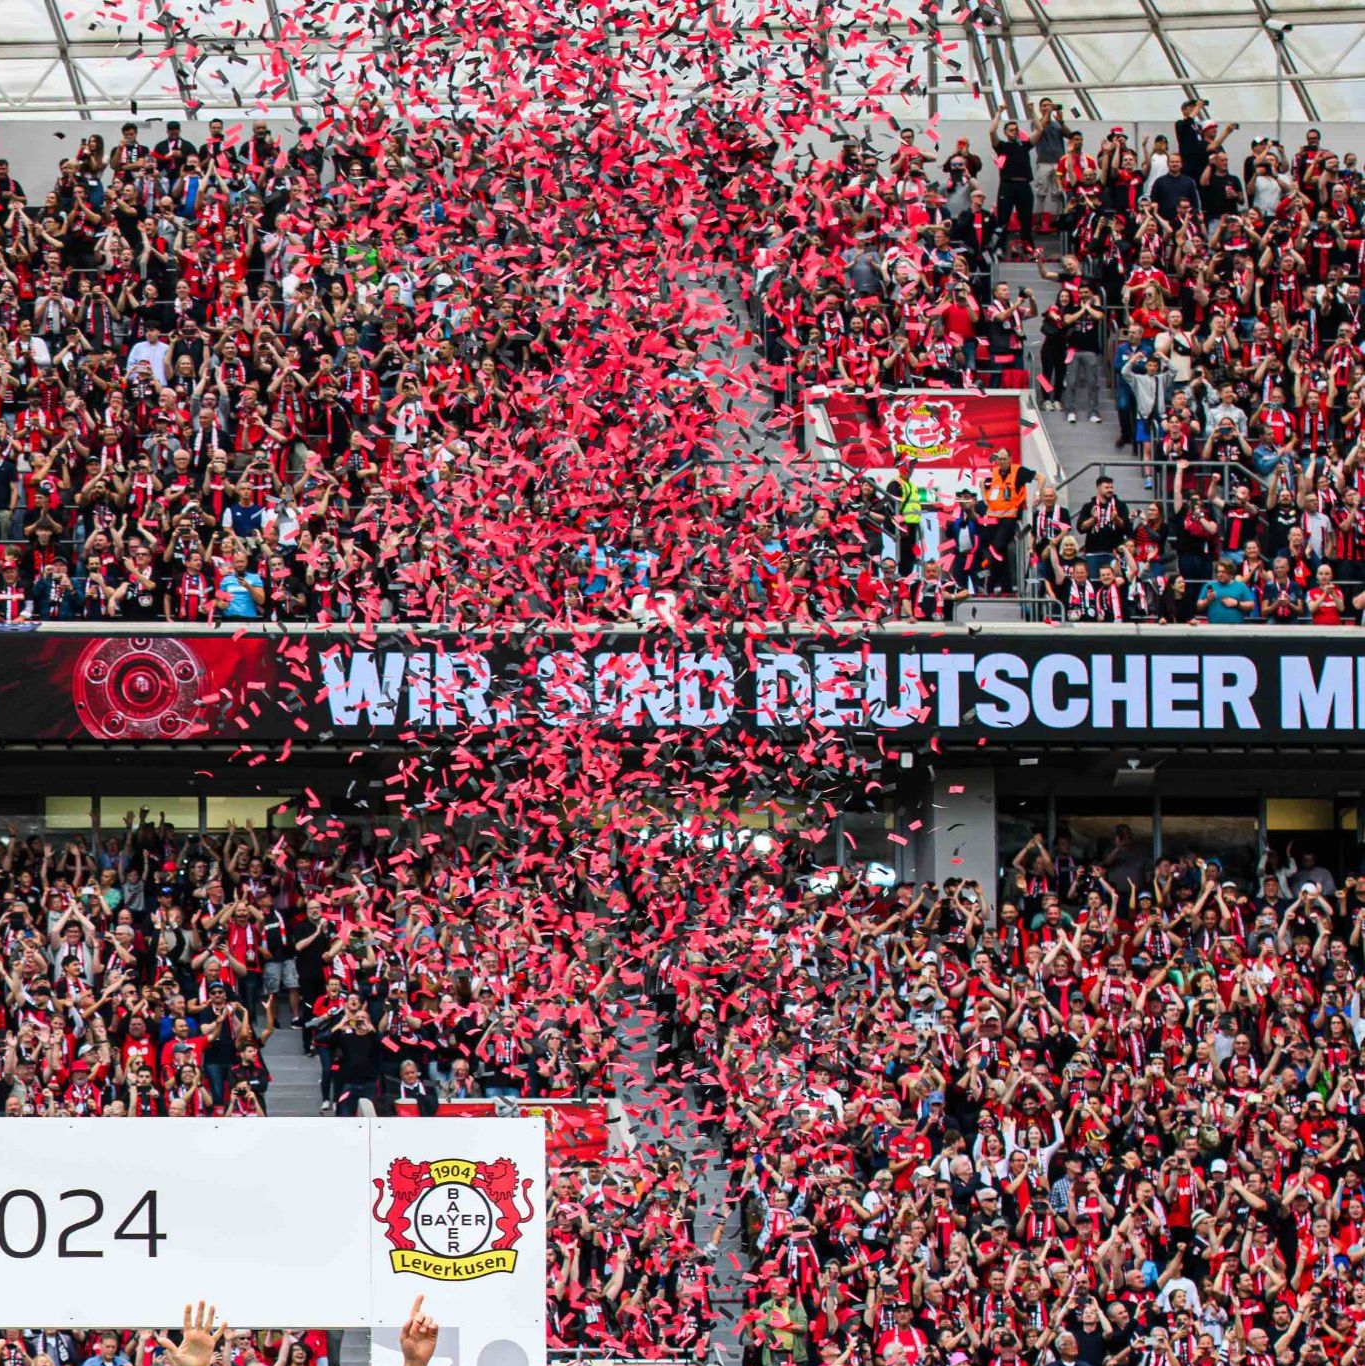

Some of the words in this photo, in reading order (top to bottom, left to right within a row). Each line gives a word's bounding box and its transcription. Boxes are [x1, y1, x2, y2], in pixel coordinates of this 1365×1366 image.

[320, 653, 496, 726] WIR
[756, 653, 1261, 729] DEUTSCHER
[1280, 656, 1365, 729] M
[434, 1165, 471, 1179] 1904
[421, 1214, 486, 1226] BAYER
[447, 1188, 459, 1252] BAYER
[401, 1254, 506, 1277] Leverkusen
